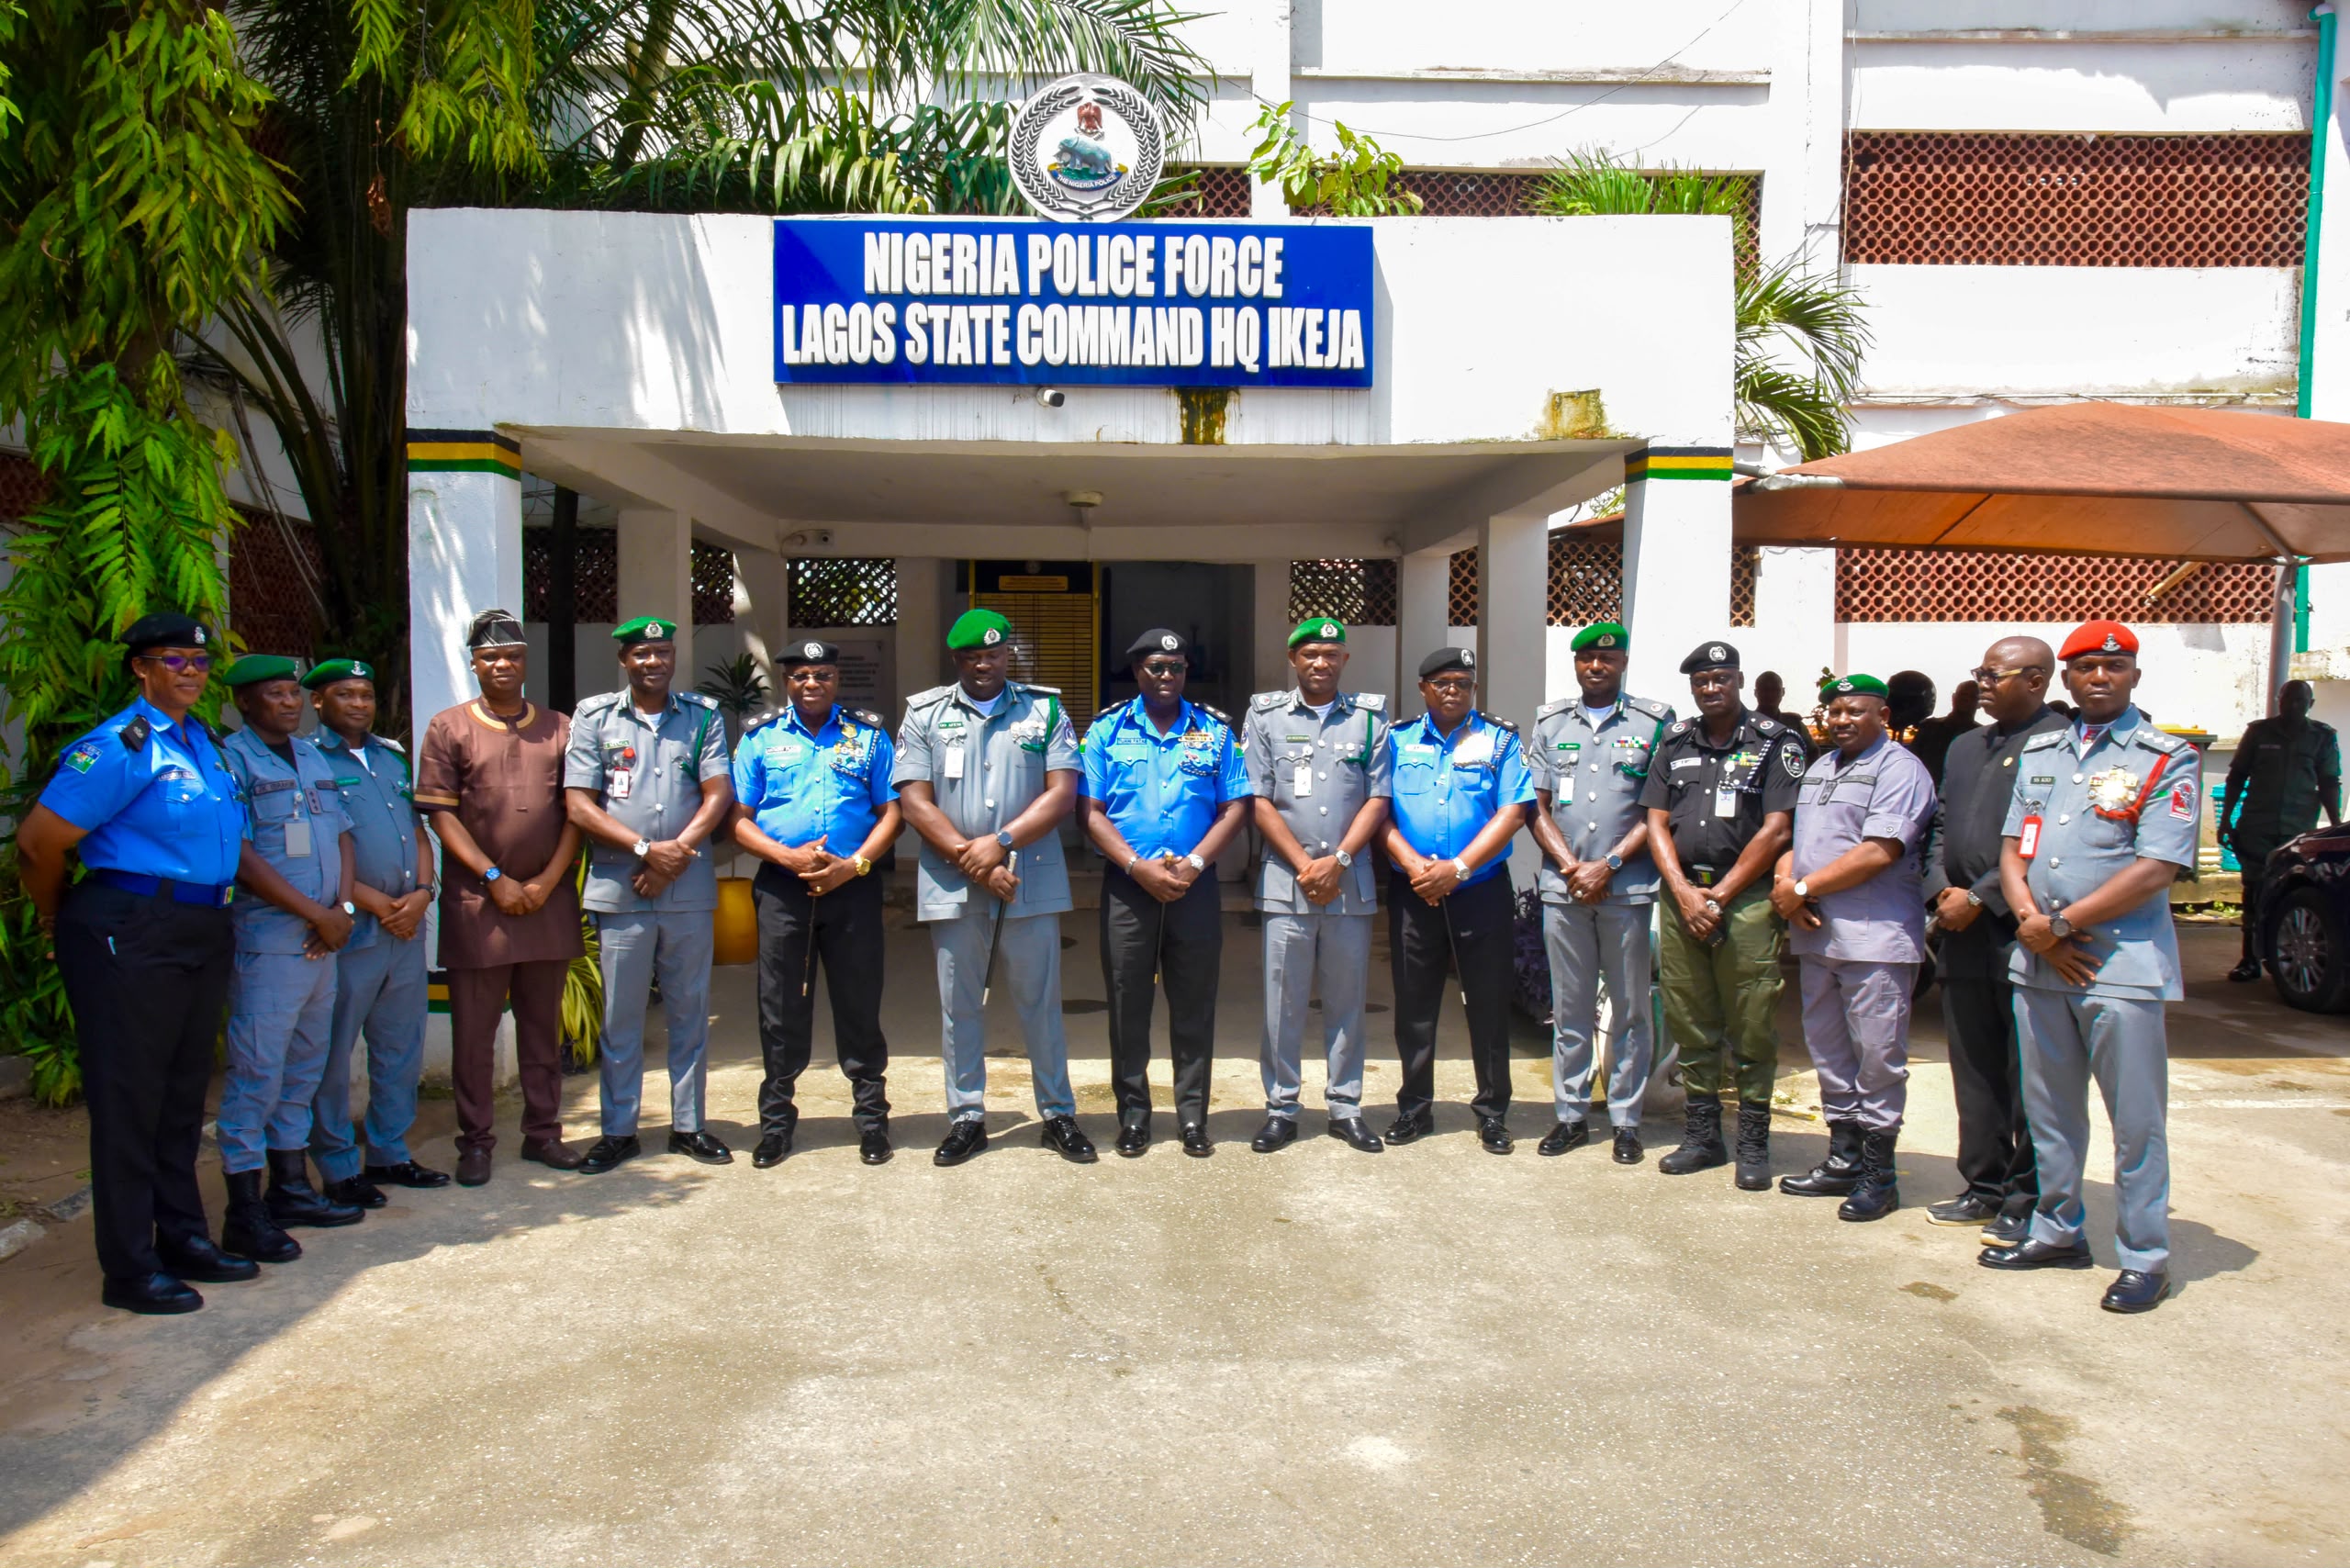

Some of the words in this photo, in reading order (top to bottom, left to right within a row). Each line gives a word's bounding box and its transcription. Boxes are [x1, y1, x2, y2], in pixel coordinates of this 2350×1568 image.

[1057, 174, 1069, 185] THE
[1069, 180, 1094, 188] NIGERIA
[1095, 174, 1117, 187] POLICE
[864, 231, 1021, 296] NIGERIA
[1027, 233, 1156, 297] POLICE
[1164, 235, 1284, 298] FORCE
[782, 302, 897, 365] LAGOS
[904, 302, 1011, 365] STATE
[1016, 304, 1204, 367] COMMAND
[1211, 306, 1260, 373] HQ
[1268, 307, 1365, 369] IKEJA
